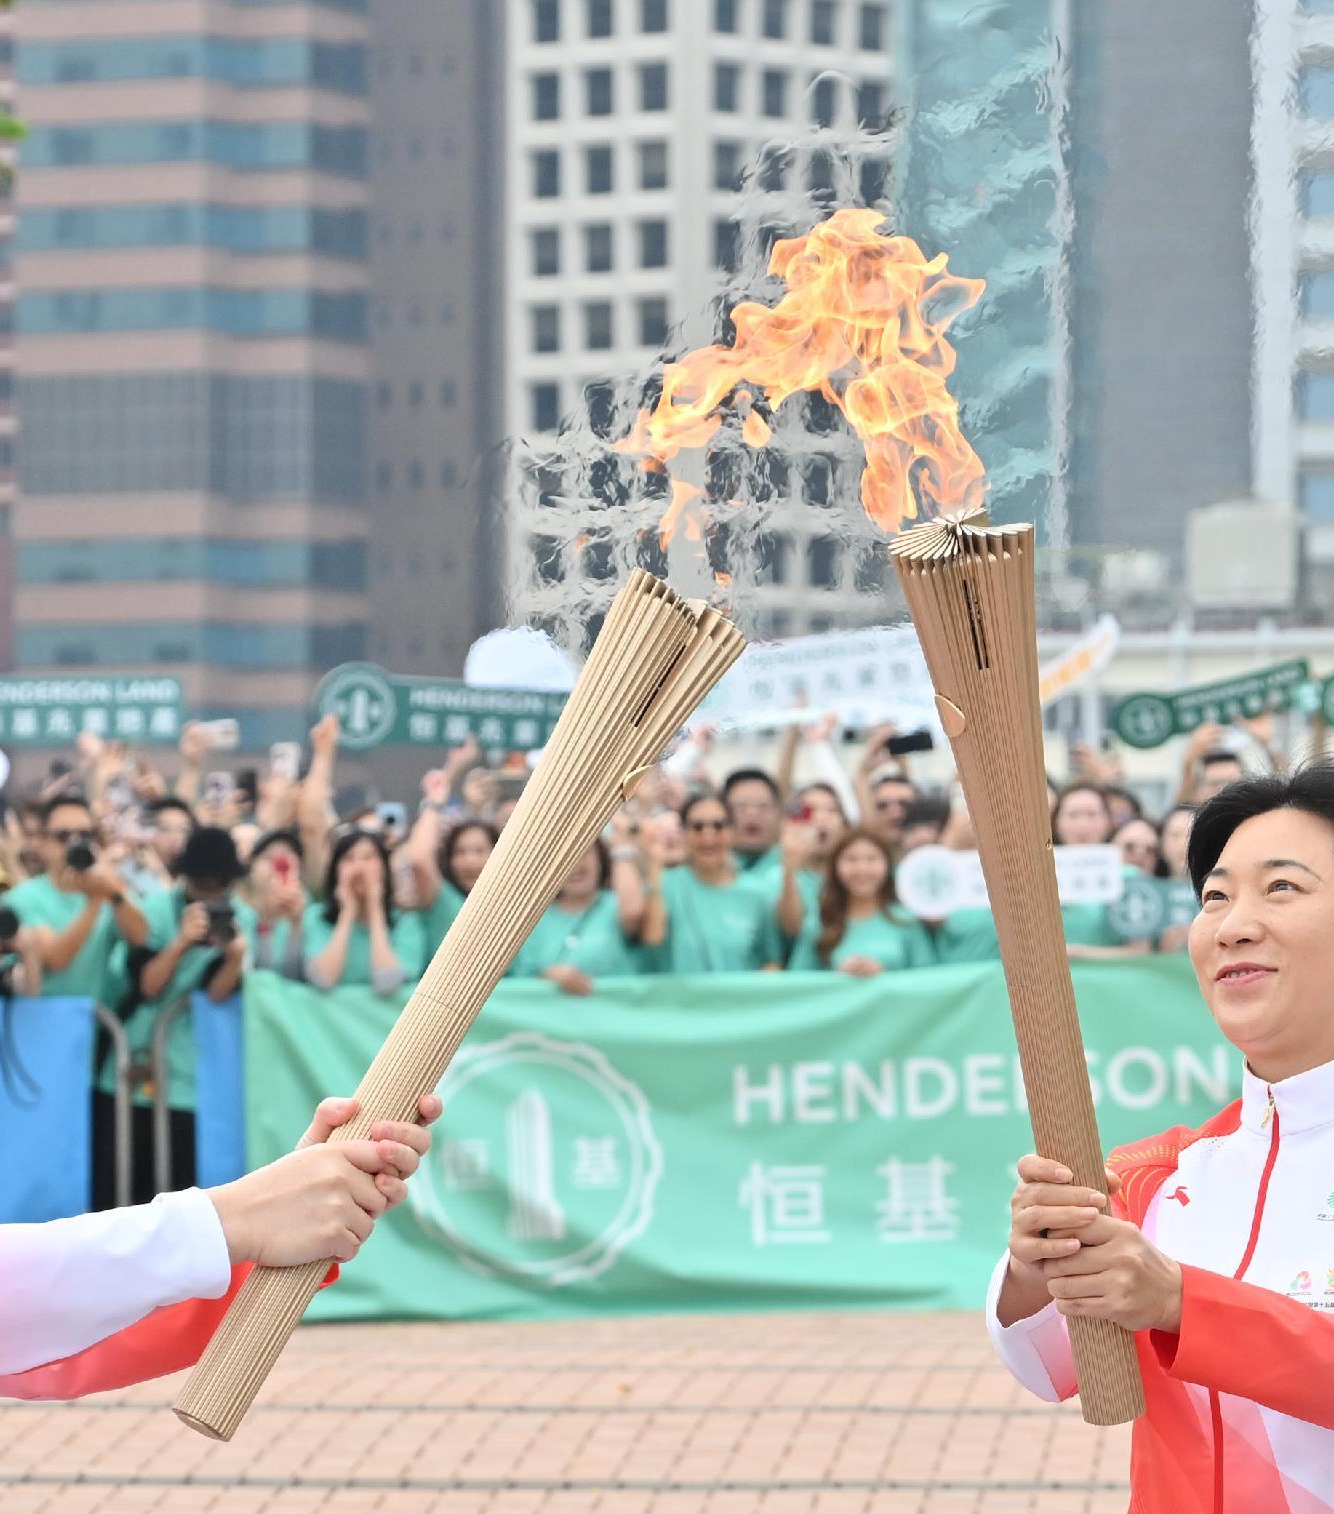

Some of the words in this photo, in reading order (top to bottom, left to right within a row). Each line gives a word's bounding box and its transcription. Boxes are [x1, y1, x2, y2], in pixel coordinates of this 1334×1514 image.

[116, 678, 181, 704] LAND
[732, 1045, 1230, 1126] HENDEON
[736, 1154, 1021, 1248] 恒基
